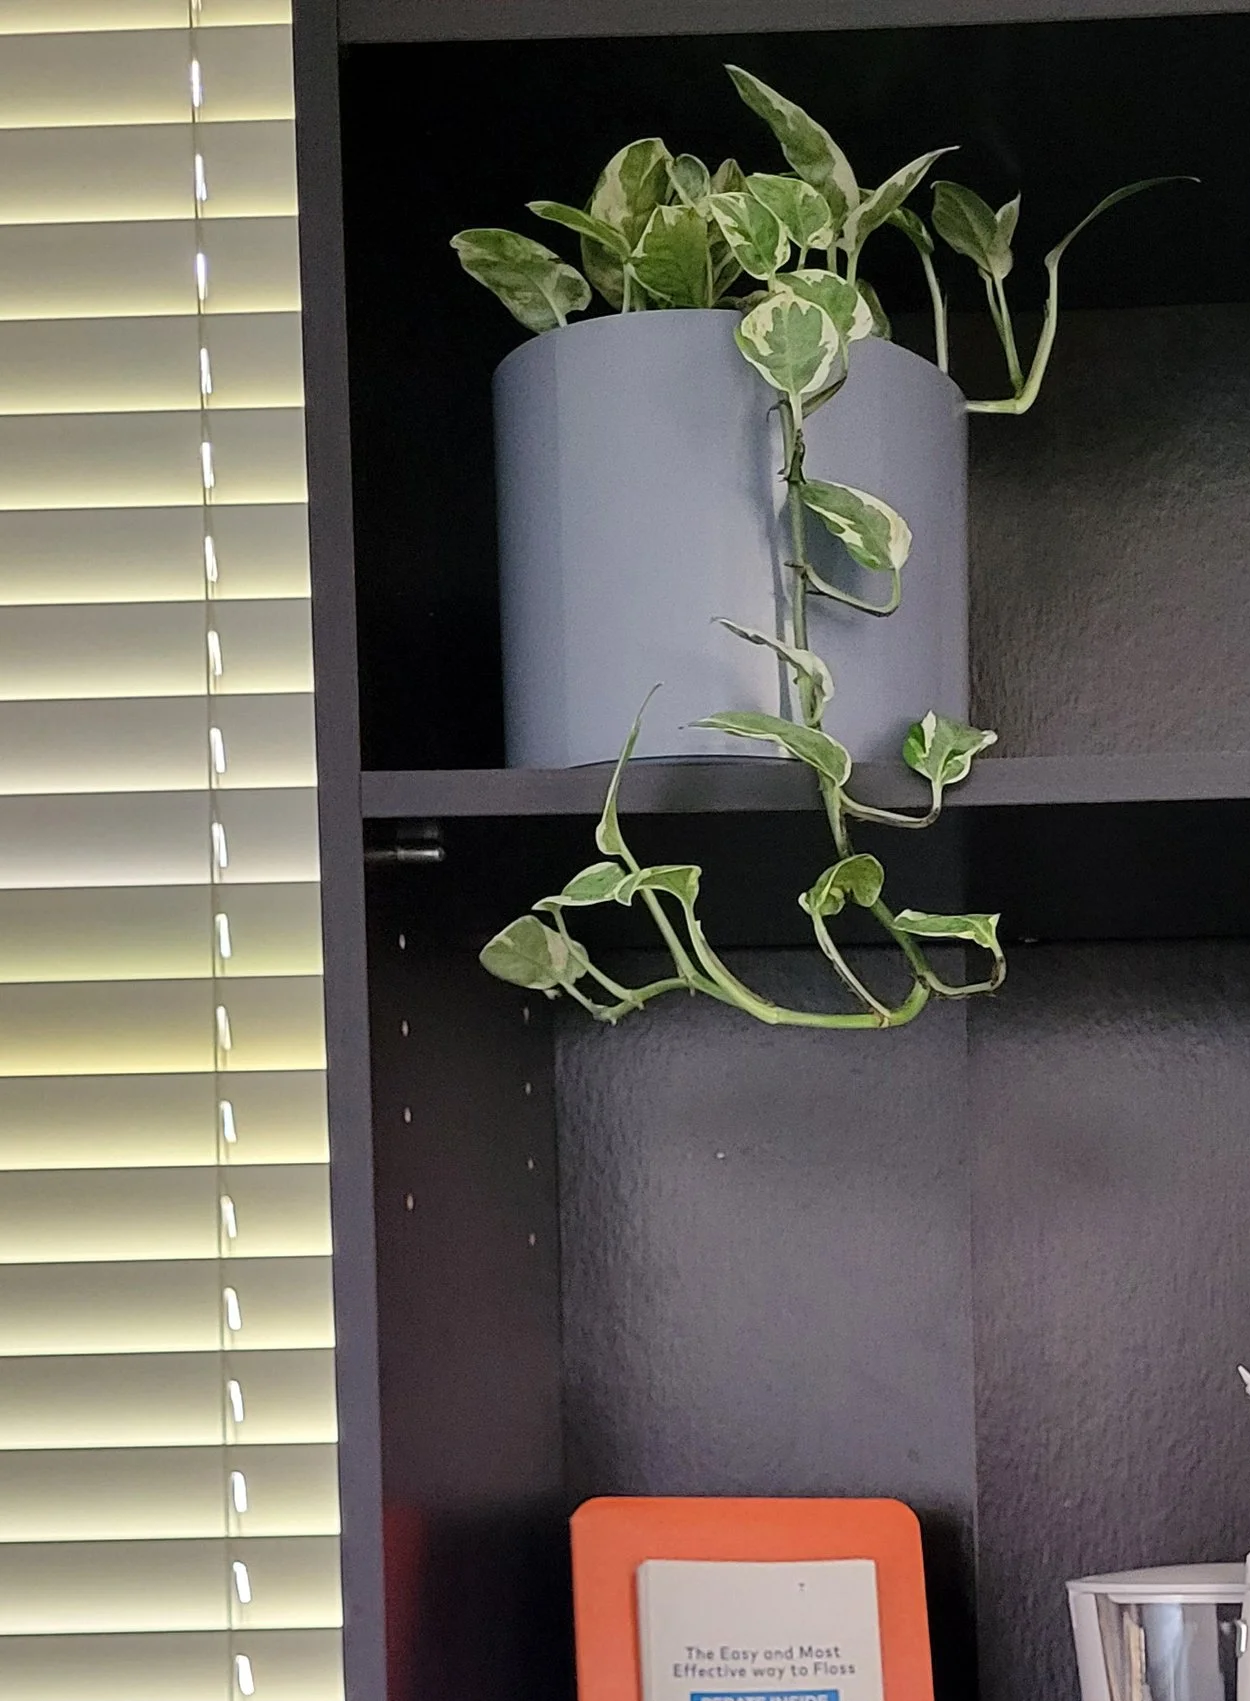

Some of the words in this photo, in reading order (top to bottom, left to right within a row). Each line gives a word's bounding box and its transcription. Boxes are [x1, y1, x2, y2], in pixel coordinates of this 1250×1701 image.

[685, 1647, 714, 1660] The
[720, 1647, 759, 1663] Easy
[764, 1646, 793, 1660] and
[799, 1645, 841, 1659] Most
[673, 1663, 747, 1679] Effective
[752, 1664, 785, 1680] way
[791, 1663, 808, 1677] to
[813, 1661, 856, 1676] Floss
